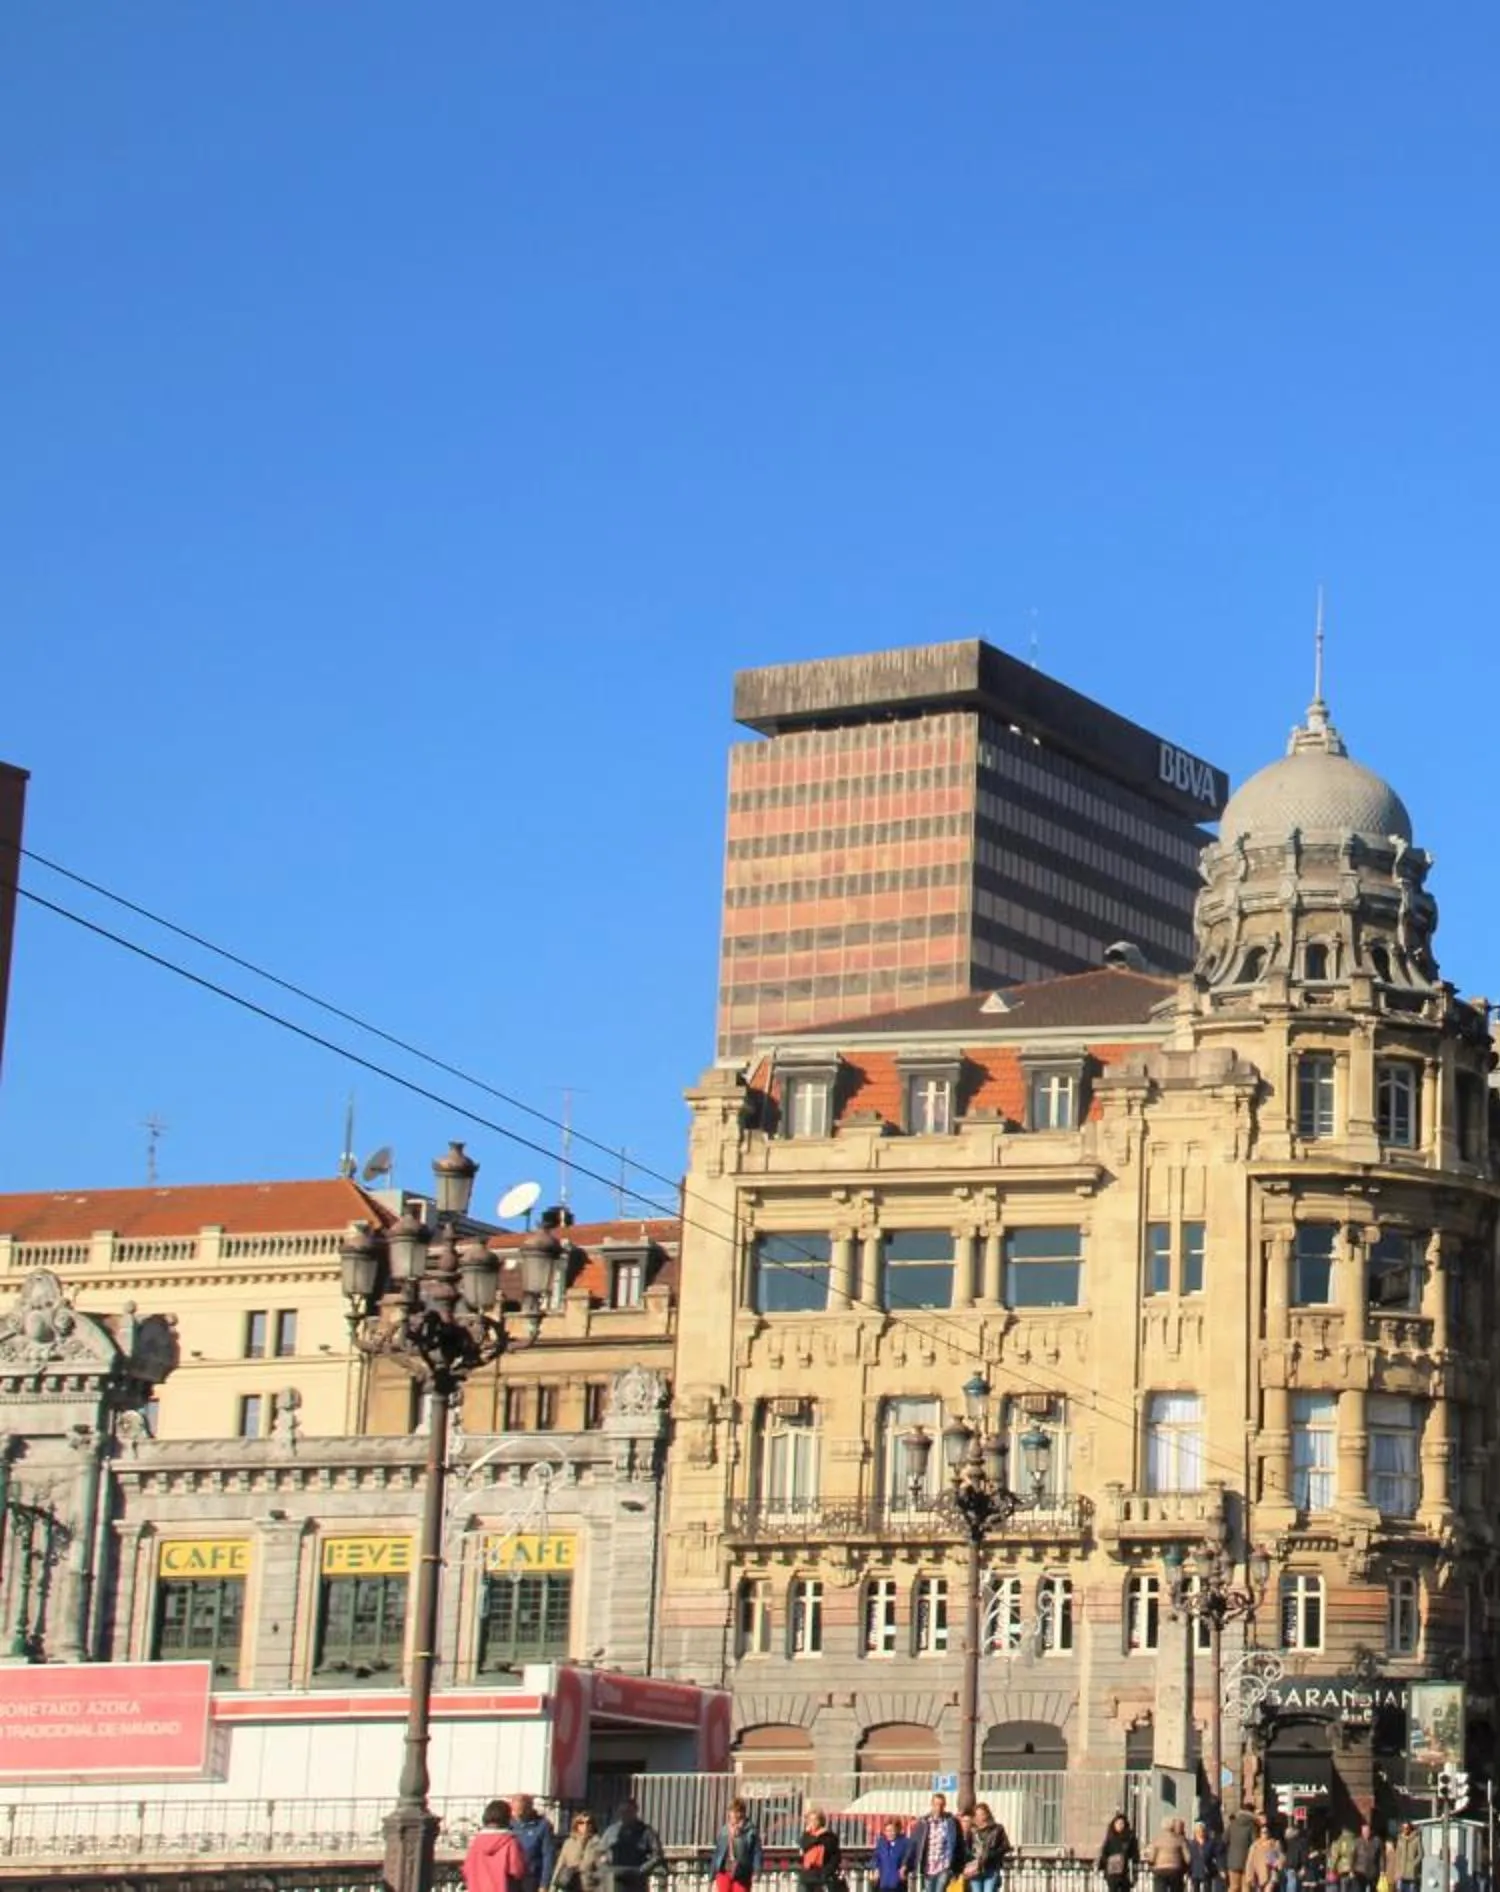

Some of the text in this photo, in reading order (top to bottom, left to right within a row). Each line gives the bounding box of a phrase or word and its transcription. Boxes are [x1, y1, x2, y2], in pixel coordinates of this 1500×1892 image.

[1159, 742, 1217, 808] BBVA
[164, 1545, 245, 1570] CAFE
[326, 1543, 408, 1568] FEVE
